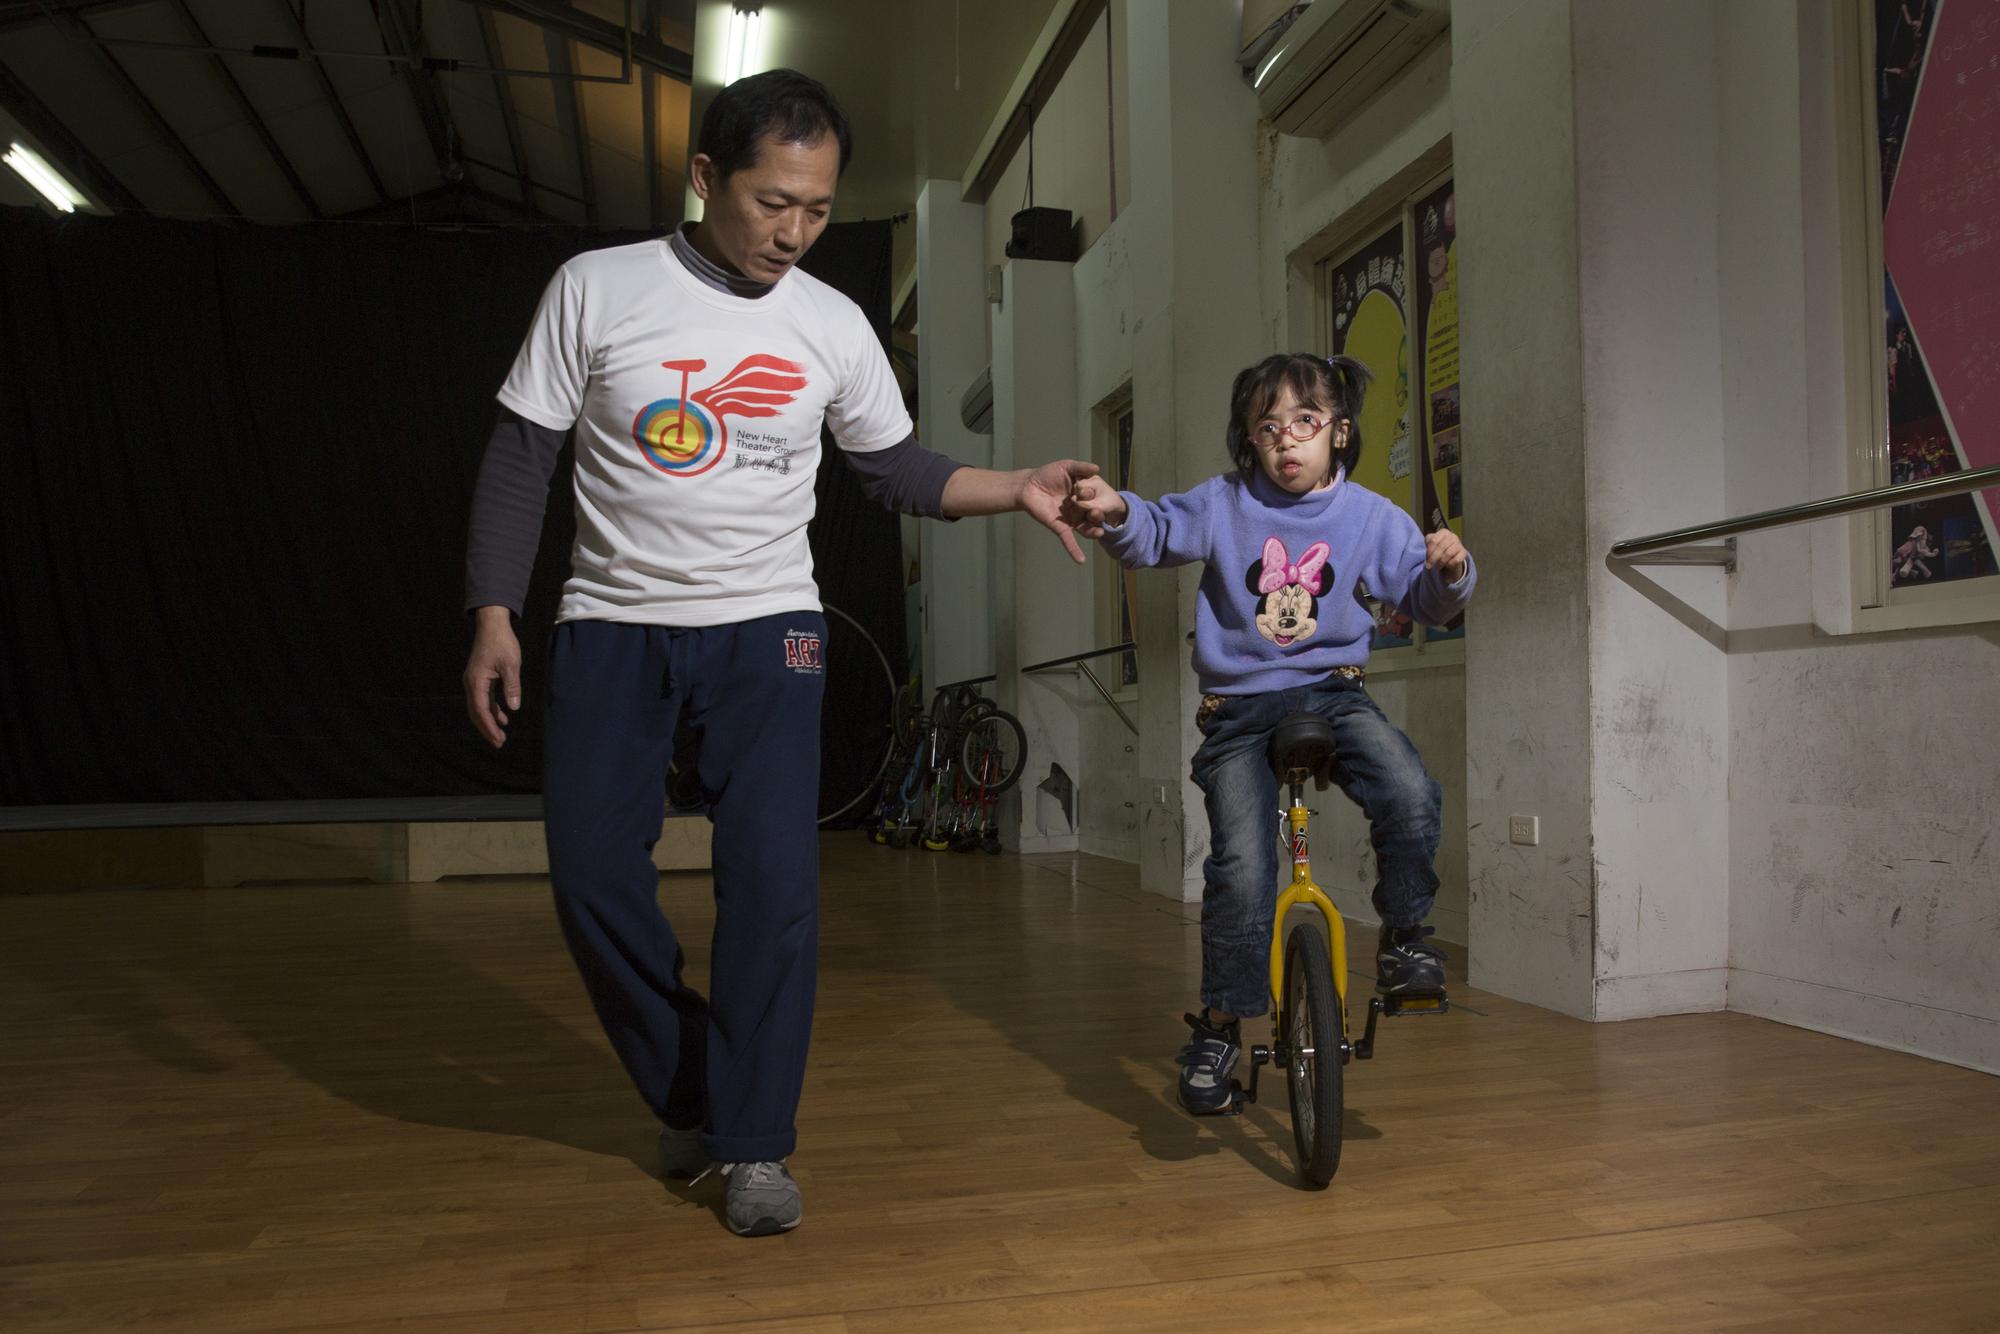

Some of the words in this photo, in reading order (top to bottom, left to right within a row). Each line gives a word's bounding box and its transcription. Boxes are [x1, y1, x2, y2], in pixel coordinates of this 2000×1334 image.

[736, 429, 760, 441] New
[762, 433, 788, 445] Heart
[735, 438, 772, 452] Theater
